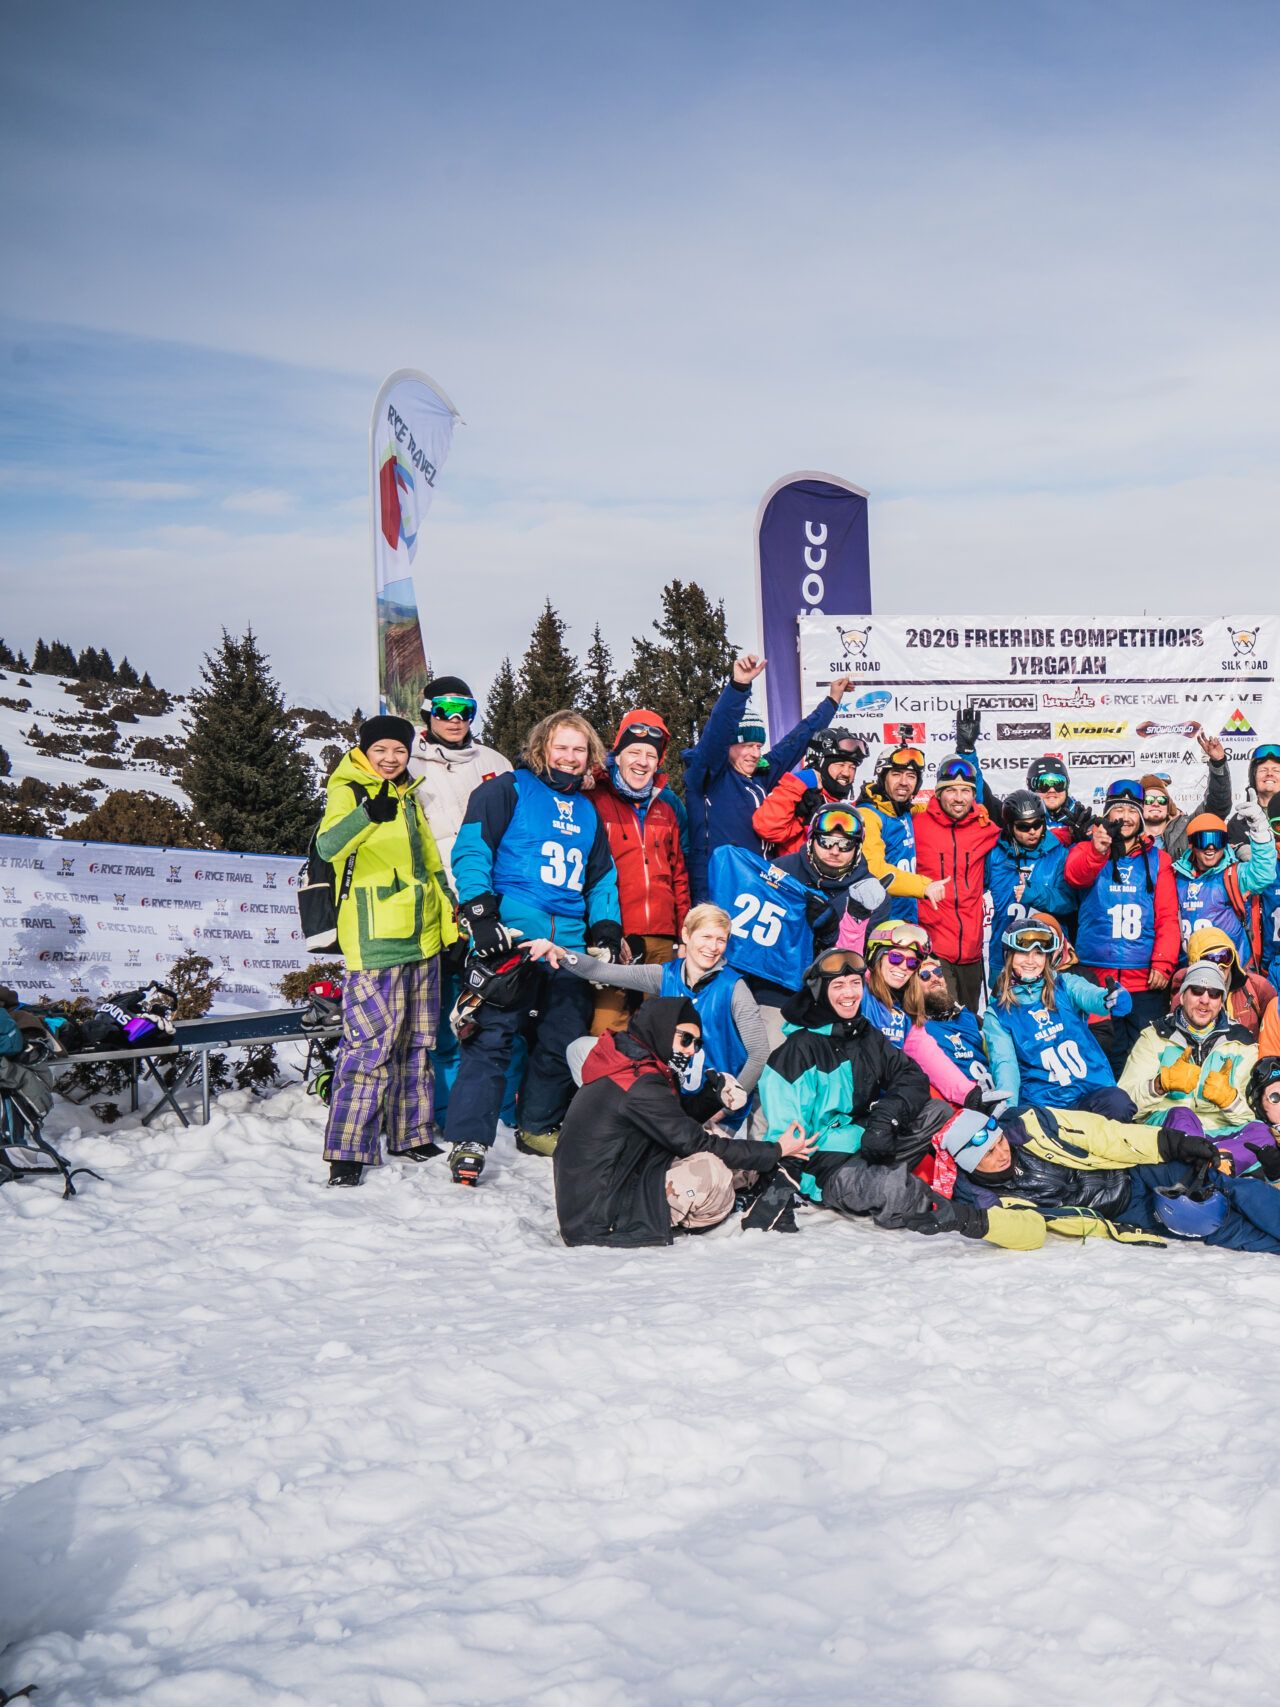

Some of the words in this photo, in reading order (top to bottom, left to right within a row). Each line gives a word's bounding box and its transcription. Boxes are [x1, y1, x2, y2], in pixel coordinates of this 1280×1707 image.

[387, 403, 408, 443] RYCE
[408, 431, 437, 488] TRAVEL
[905, 628, 959, 648] 2020
[964, 628, 1056, 648] FREERIDE
[1060, 628, 1204, 648] COMPETITIONS
[829, 662, 851, 672] SILK
[855, 661, 881, 672] ROAD
[1009, 656, 1107, 675] JYRGALAN
[1221, 660, 1242, 670] SILK
[1245, 660, 1268, 670] ROAD
[894, 696, 961, 711] Karibu
[970, 697, 1034, 709] FACTION
[1114, 695, 1139, 705] RYCE
[1141, 694, 1179, 705] TRAVEL
[1185, 693, 1263, 702] NATIVE
[1071, 754, 1132, 766] FACTION
[552, 820, 566, 830] SILK
[566, 822, 581, 833] ROAD
[10, 858, 45, 870] TRAVEL
[540, 840, 584, 892] 32
[100, 864, 123, 875] RYCE
[125, 866, 156, 877] TRAVEL
[204, 871, 225, 881] RYCE
[226, 872, 254, 883] TRAVEL
[1109, 884, 1122, 893] SILK
[1122, 885, 1137, 893] ROAD
[151, 899, 172, 909] RYCE
[174, 899, 203, 910] TRAVEL
[249, 904, 269, 914] RYCE
[270, 904, 299, 915] TRAVEL
[20, 918, 56, 928] TRAVEL
[731, 893, 787, 947] 25
[1106, 903, 1142, 940] 18
[203, 929, 222, 938] RYCE
[223, 929, 253, 940] TRAVEL
[252, 959, 271, 969] RYCE
[272, 959, 301, 969] TRAVEL
[15, 980, 56, 989] TRAVEL
[235, 983, 260, 993] TRAVEL
[1034, 1029, 1049, 1041] SILK
[1047, 1022, 1064, 1036] ROAD
[1040, 1040, 1087, 1087] 40
